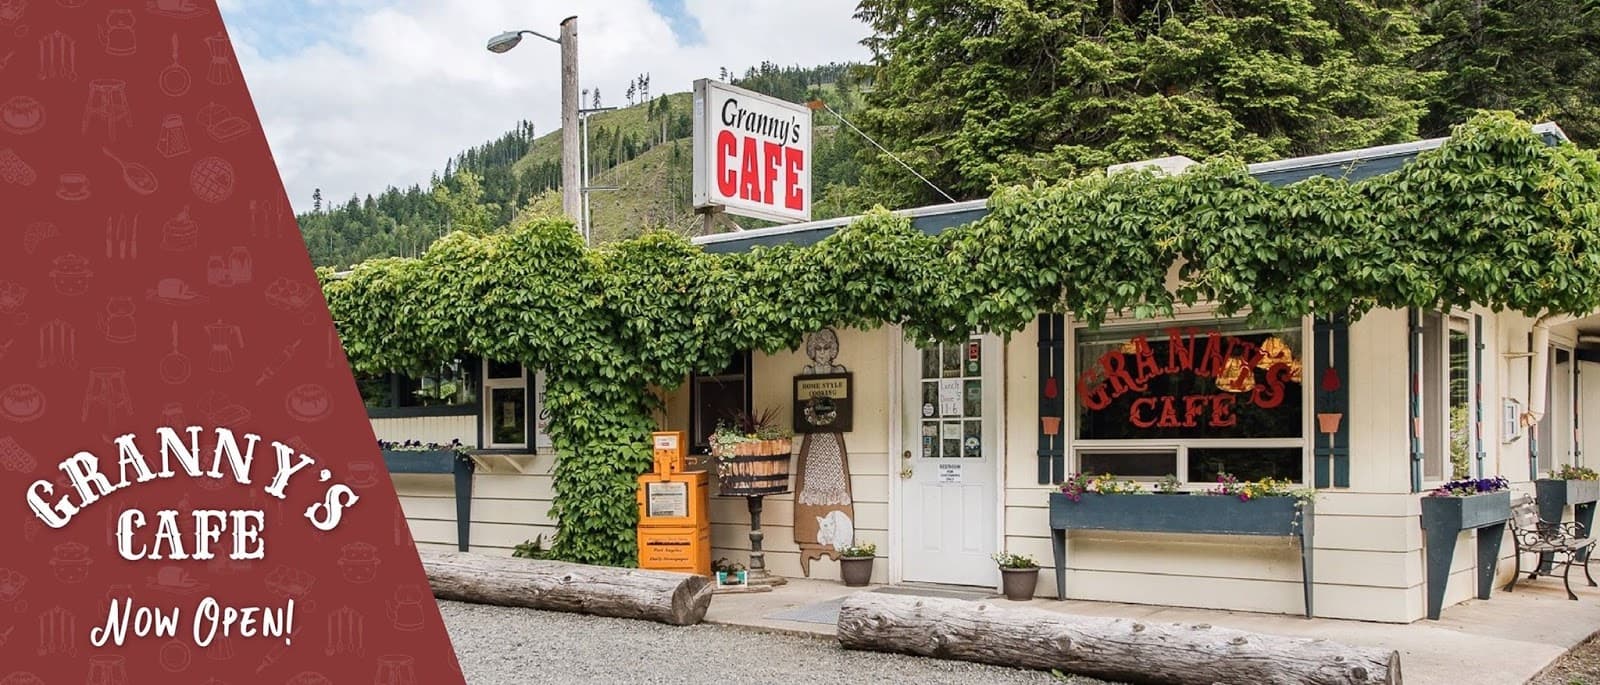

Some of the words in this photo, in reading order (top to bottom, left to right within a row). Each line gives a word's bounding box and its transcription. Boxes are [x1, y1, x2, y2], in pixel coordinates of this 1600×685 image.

[721, 98, 801, 147] Granny's
[716, 129, 804, 211] CAFE
[1078, 327, 1300, 410] GRANNY'S
[1129, 393, 1237, 428] CAFE
